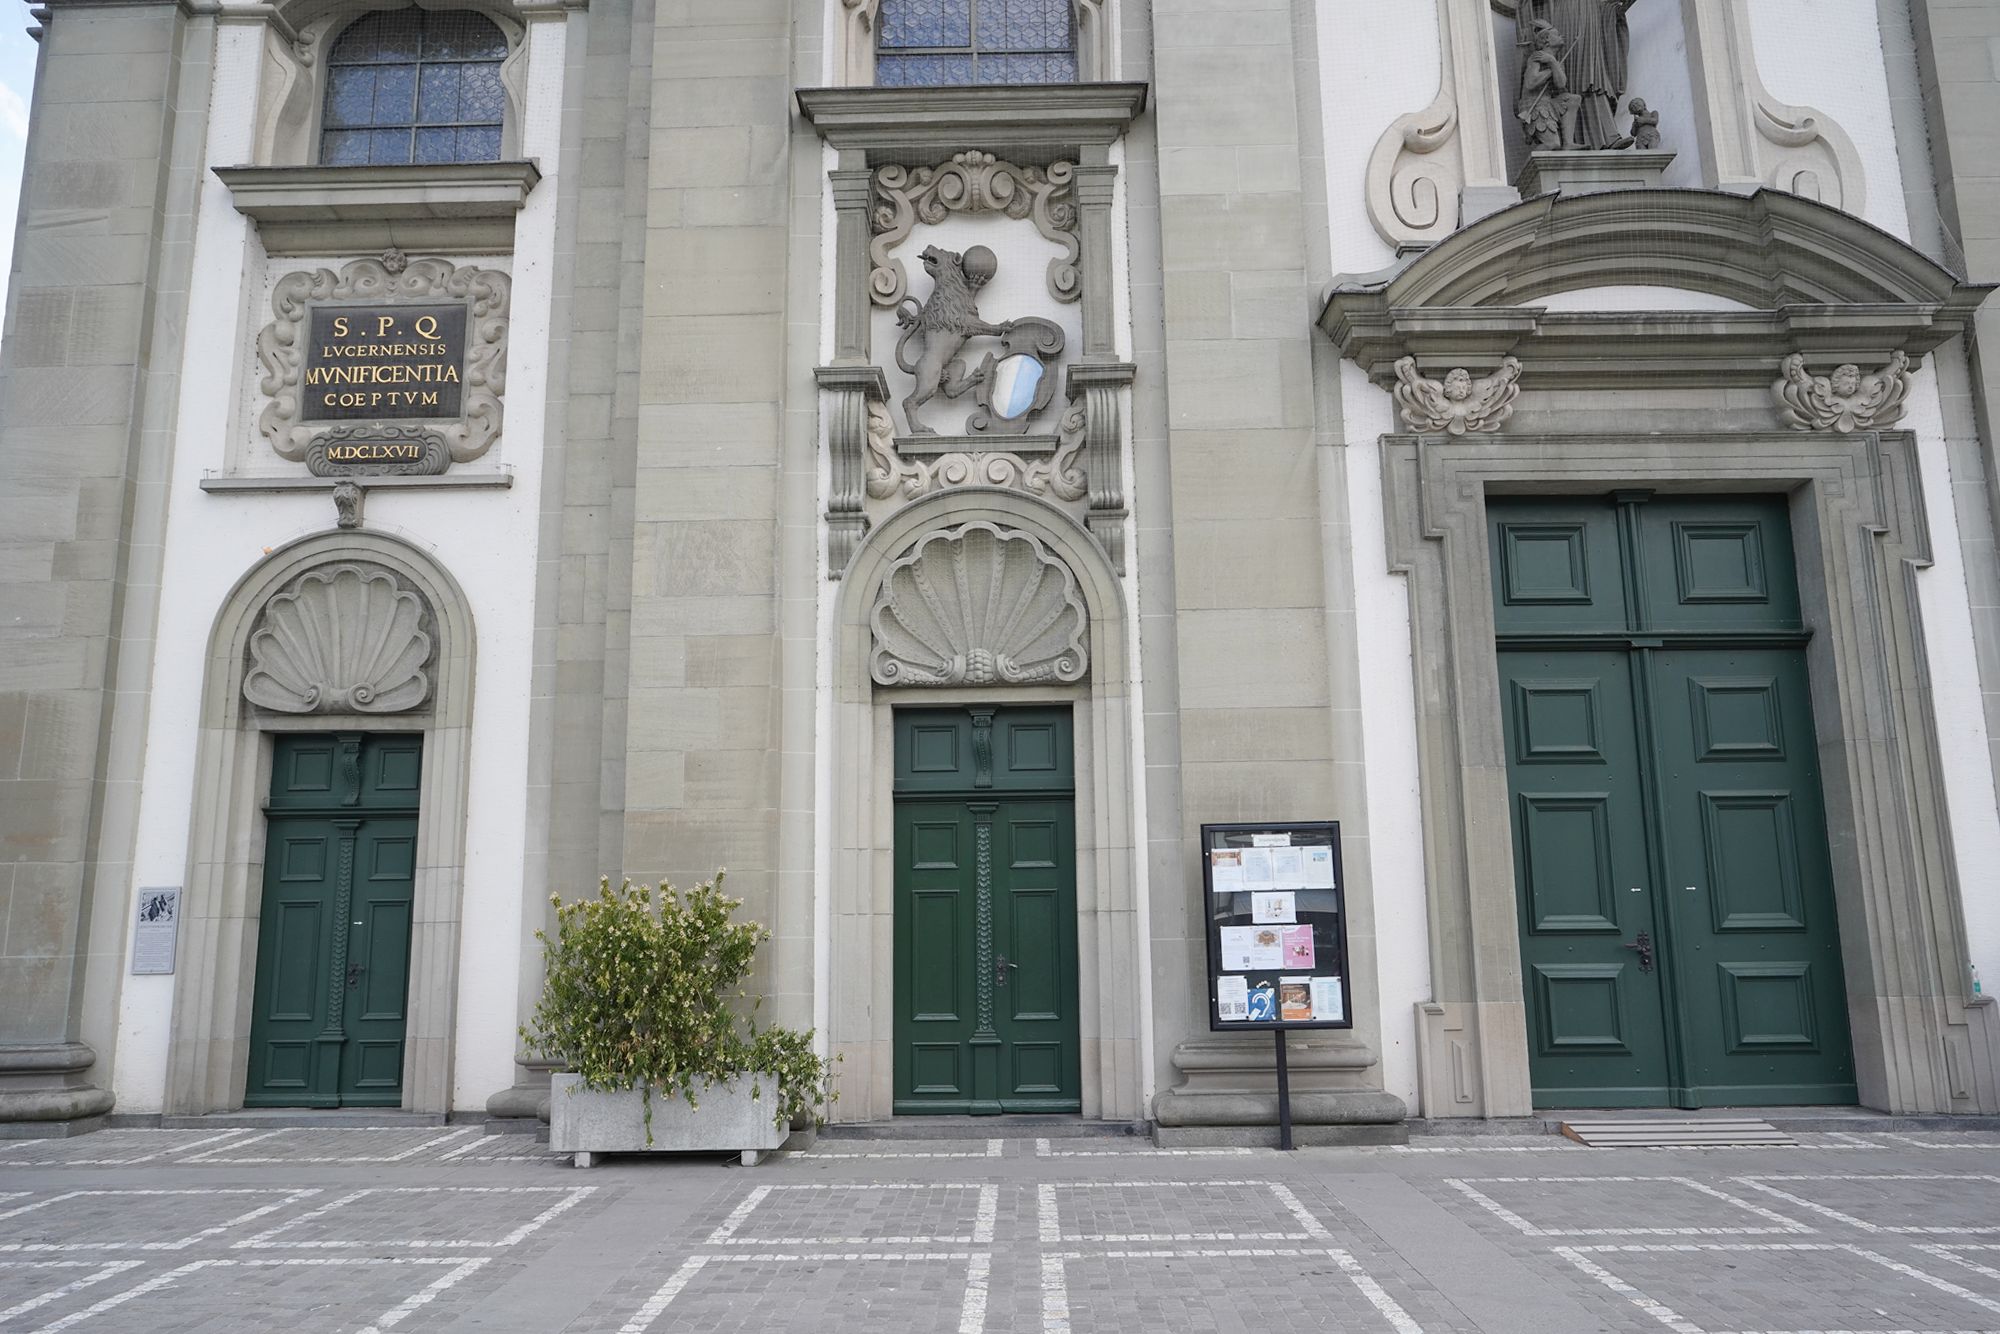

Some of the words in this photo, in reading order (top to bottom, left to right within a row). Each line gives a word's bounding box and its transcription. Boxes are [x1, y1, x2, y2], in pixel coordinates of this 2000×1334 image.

[323, 343, 446, 358] LVCERNENSIS
[306, 364, 460, 385] MVNIFICENTIA
[324, 391, 438, 406] COEPTVM
